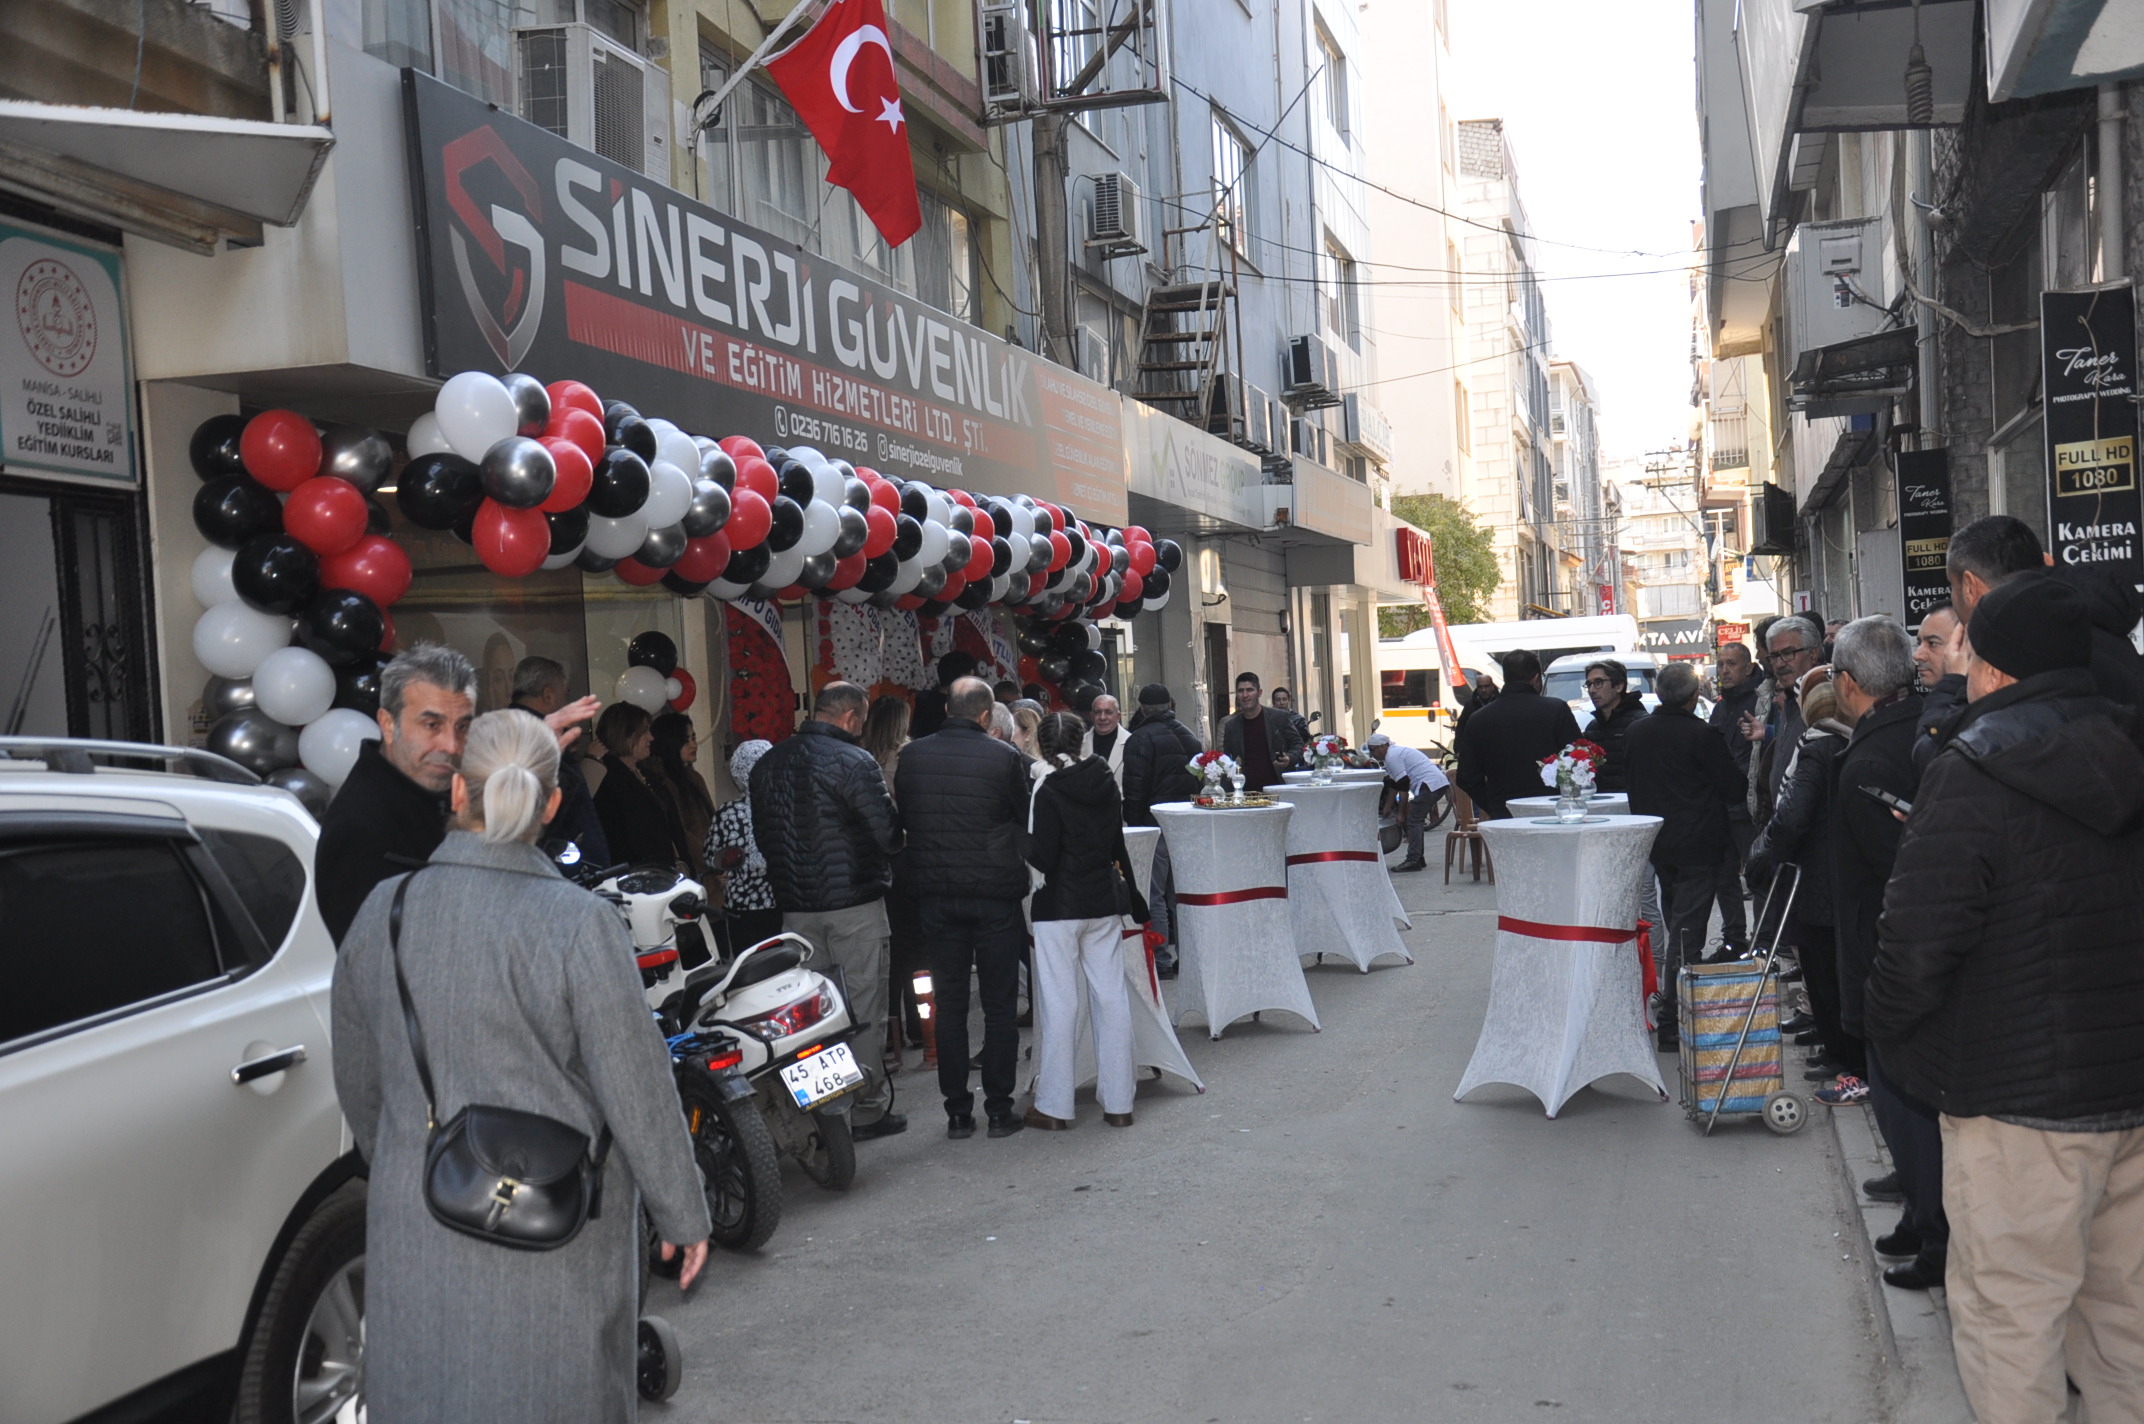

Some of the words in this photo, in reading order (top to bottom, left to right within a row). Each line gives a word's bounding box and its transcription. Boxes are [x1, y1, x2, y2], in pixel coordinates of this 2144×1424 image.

[555, 157, 817, 354] SİNERJİ
[829, 278, 1032, 427] GÜVENLİK
[2056, 346, 2119, 377] Taner
[2083, 366, 2126, 387] Kara
[681, 326, 716, 374] VE
[728, 343, 803, 399] EĞİTİM
[812, 369, 918, 433] HİZMETLERİ
[925, 405, 957, 444] LTD.
[963, 419, 989, 456] ŞTİ.
[2099, 386, 2132, 397] WEDDING
[27, 397, 57, 419] ÖZEL
[59, 406, 101, 427] SALİHLİ
[18, 434, 58, 456] EĞİTİM
[60, 443, 114, 464] KURSLARI
[790, 412, 821, 441] 0236
[822, 421, 841, 445] 716
[842, 425, 854, 449] 16
[855, 430, 868, 452] 26
[889, 439, 964, 477] sinerjiozelguvenlik
[2058, 448, 2101, 466] FULL
[2106, 445, 2130, 460] HD
[1184, 440, 1219, 488] SÖNMEZ
[2071, 468, 2118, 489] 1080
[2058, 521, 2136, 541] KAMERA
[1907, 544, 1932, 555] FULL
[1934, 542, 1948, 552] HD
[1915, 555, 1941, 567] 1080
[1907, 585, 1951, 597] KAMERA
[788, 1063, 808, 1083] 45
[818, 1046, 846, 1070] ATP
[814, 1072, 843, 1095] 468
